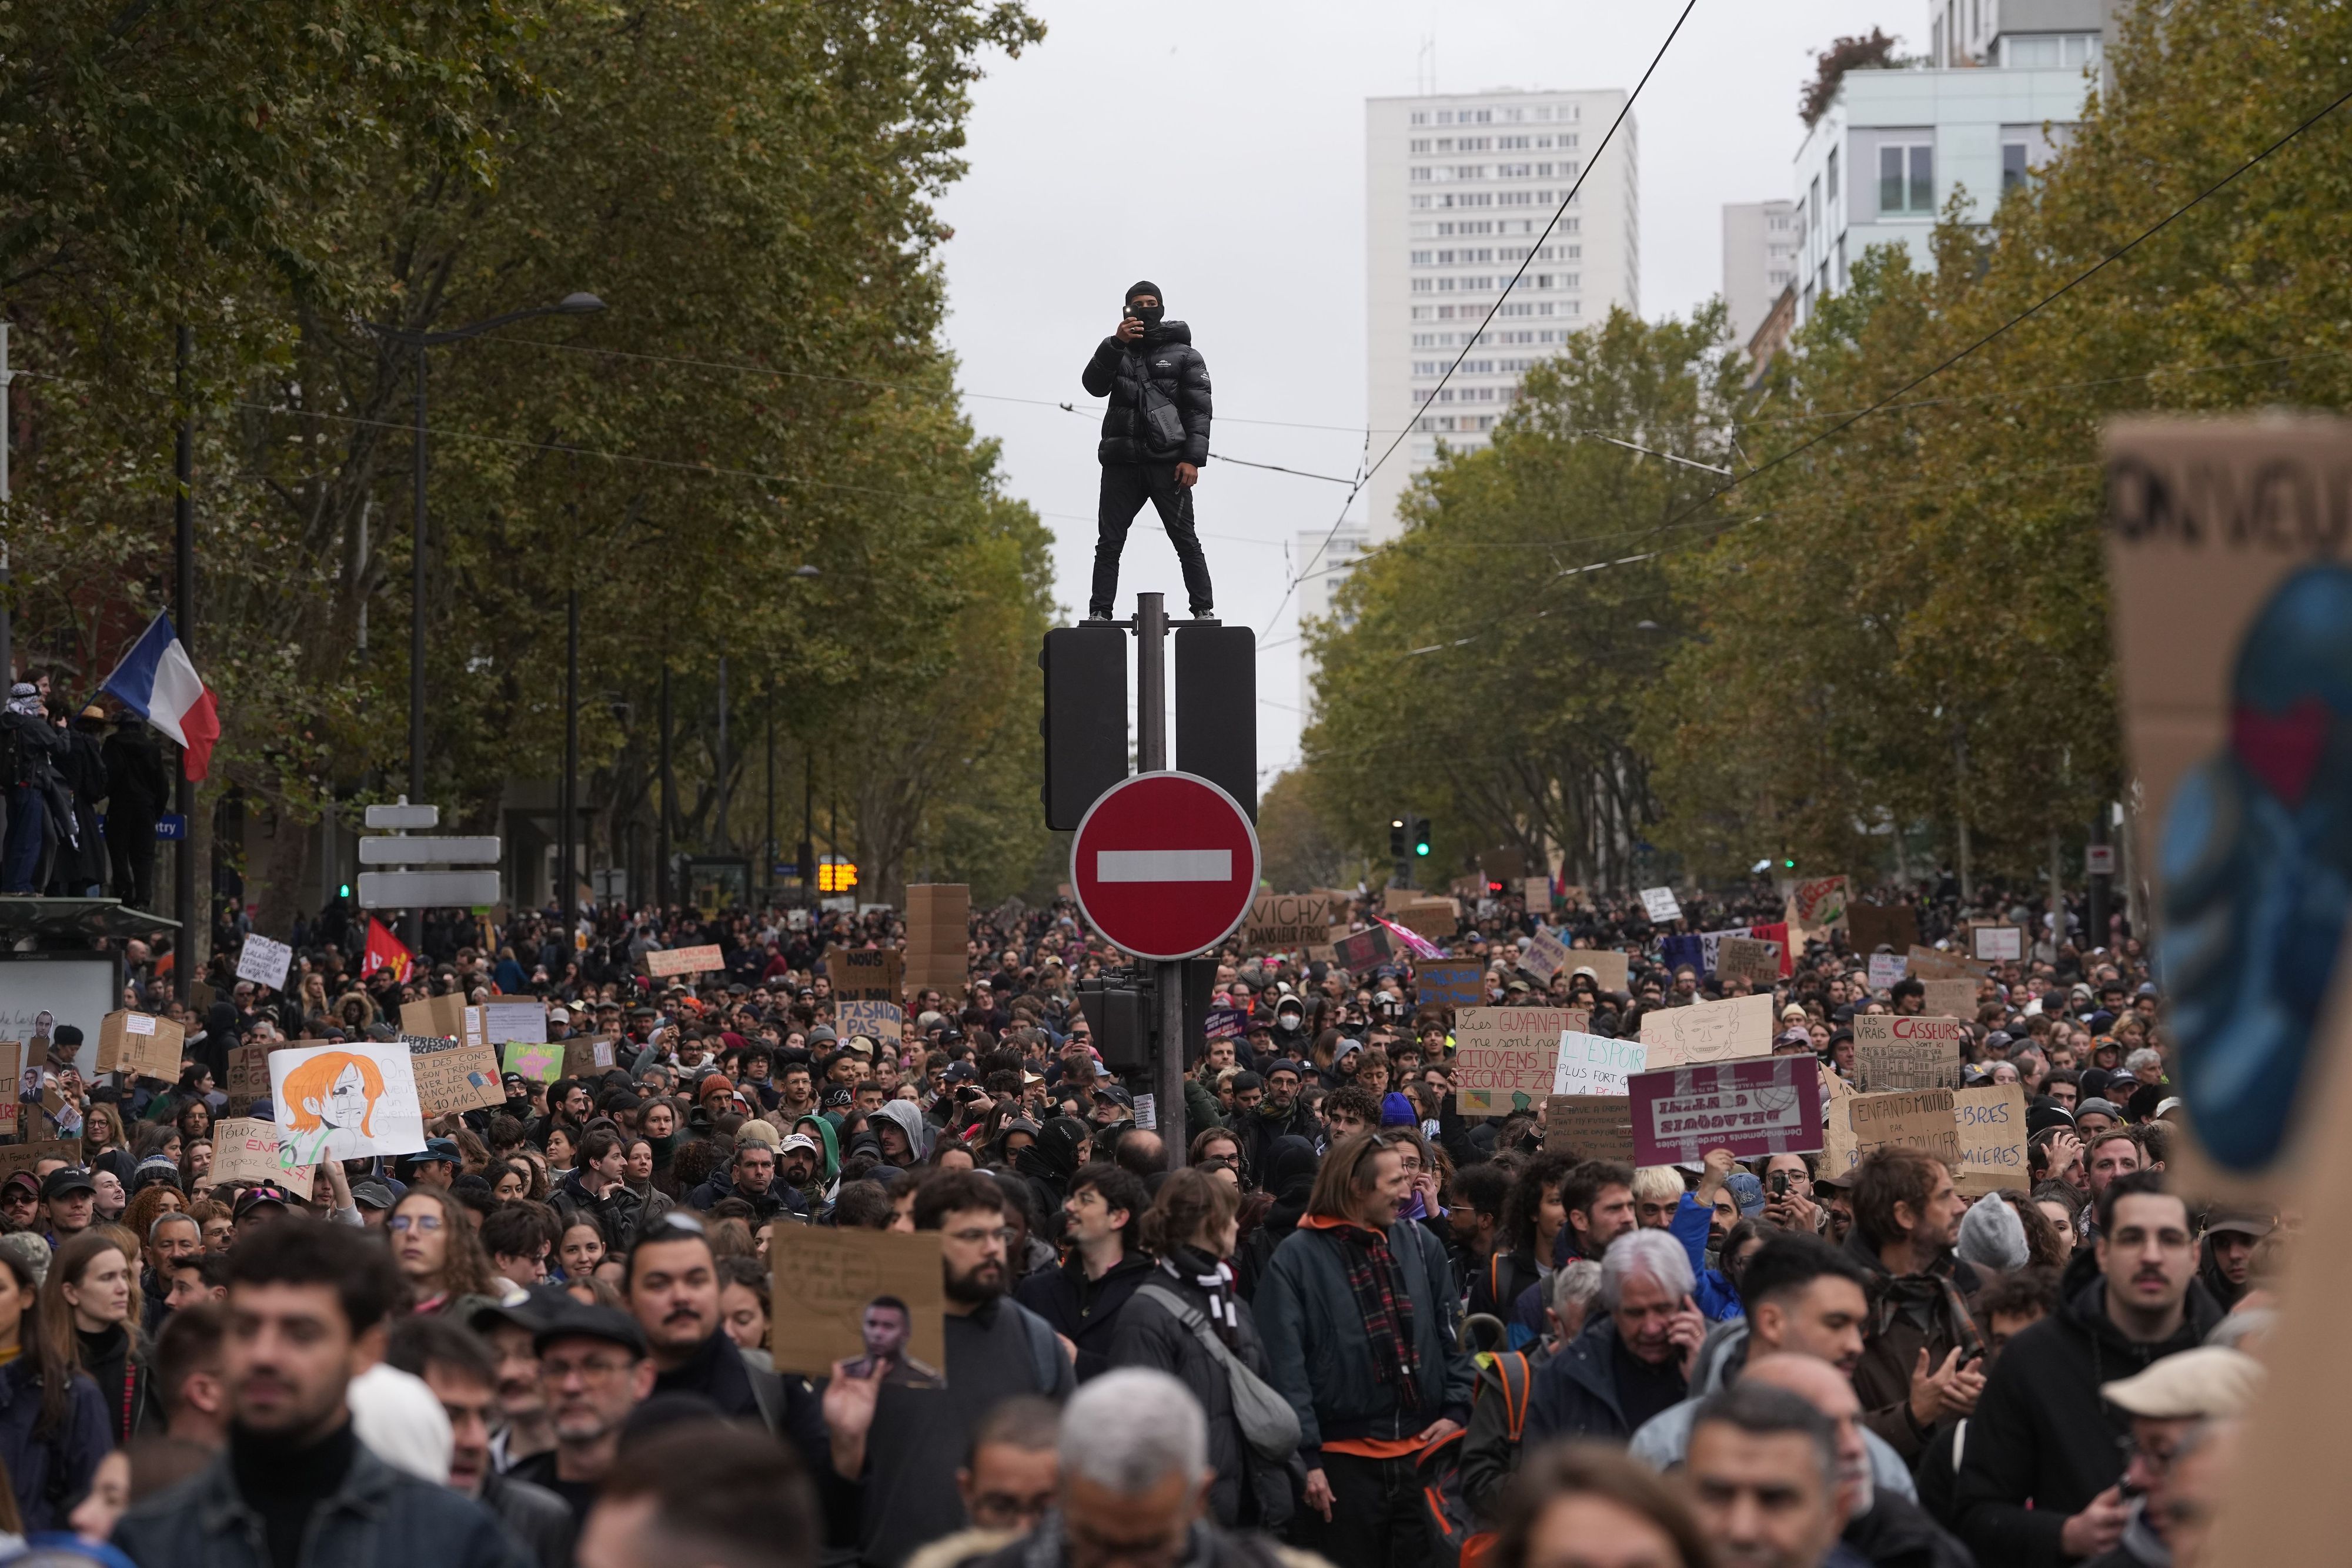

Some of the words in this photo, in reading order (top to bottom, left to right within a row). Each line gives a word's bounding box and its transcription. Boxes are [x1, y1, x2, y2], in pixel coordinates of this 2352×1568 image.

[1252, 898, 1327, 925] VICHY
[1301, 925, 1328, 941] FROC
[847, 951, 883, 967] NOUS
[840, 1001, 901, 1025] FASHION
[847, 1018, 880, 1035] PAS
[1893, 1018, 1959, 1040] CASSEURS
[400, 1034, 462, 1049] REPRESSION
[1471, 1038, 1491, 1048] ne
[1497, 1035, 1532, 1048] sont
[1641, 1029, 1684, 1061] OUSTE
[432, 1057, 452, 1068] DES
[459, 1051, 488, 1062] CONS
[1457, 1050, 1538, 1069] CITOYENS
[1549, 1052, 1558, 1069] D
[380, 1058, 407, 1079] On
[422, 1070, 440, 1079] SON
[445, 1062, 481, 1076] TRÔNE
[1559, 1064, 1587, 1078] PLUS
[1593, 1070, 1617, 1084] FORT
[417, 1079, 444, 1090] HIER
[447, 1074, 463, 1084] LES
[1457, 1069, 1525, 1088] SECONDE
[1532, 1070, 1554, 1089] ZO
[386, 1082, 415, 1095] veut
[418, 1084, 464, 1099] RANÇAIS
[434, 1098, 449, 1111] 10
[452, 1091, 476, 1105] ANS
[1858, 1097, 1912, 1122] ENFANTS
[1915, 1092, 1955, 1113] MUTILÉS
[376, 1106, 415, 1119] Avenir
[1552, 1105, 1565, 1115] I
[1566, 1105, 1590, 1114] HAVE
[1954, 1102, 2009, 1126] EBRES
[1661, 1109, 1781, 1134] DELACQUIS
[1890, 1124, 1904, 1132] PAR
[220, 1124, 259, 1140] Pour
[1059, 1125, 1073, 1140] NOCTA
[219, 1145, 240, 1155] des
[245, 1139, 279, 1153] ENF
[1581, 1141, 1598, 1150] THEY
[217, 1157, 261, 1174] Taper
[264, 1156, 280, 1170] le
